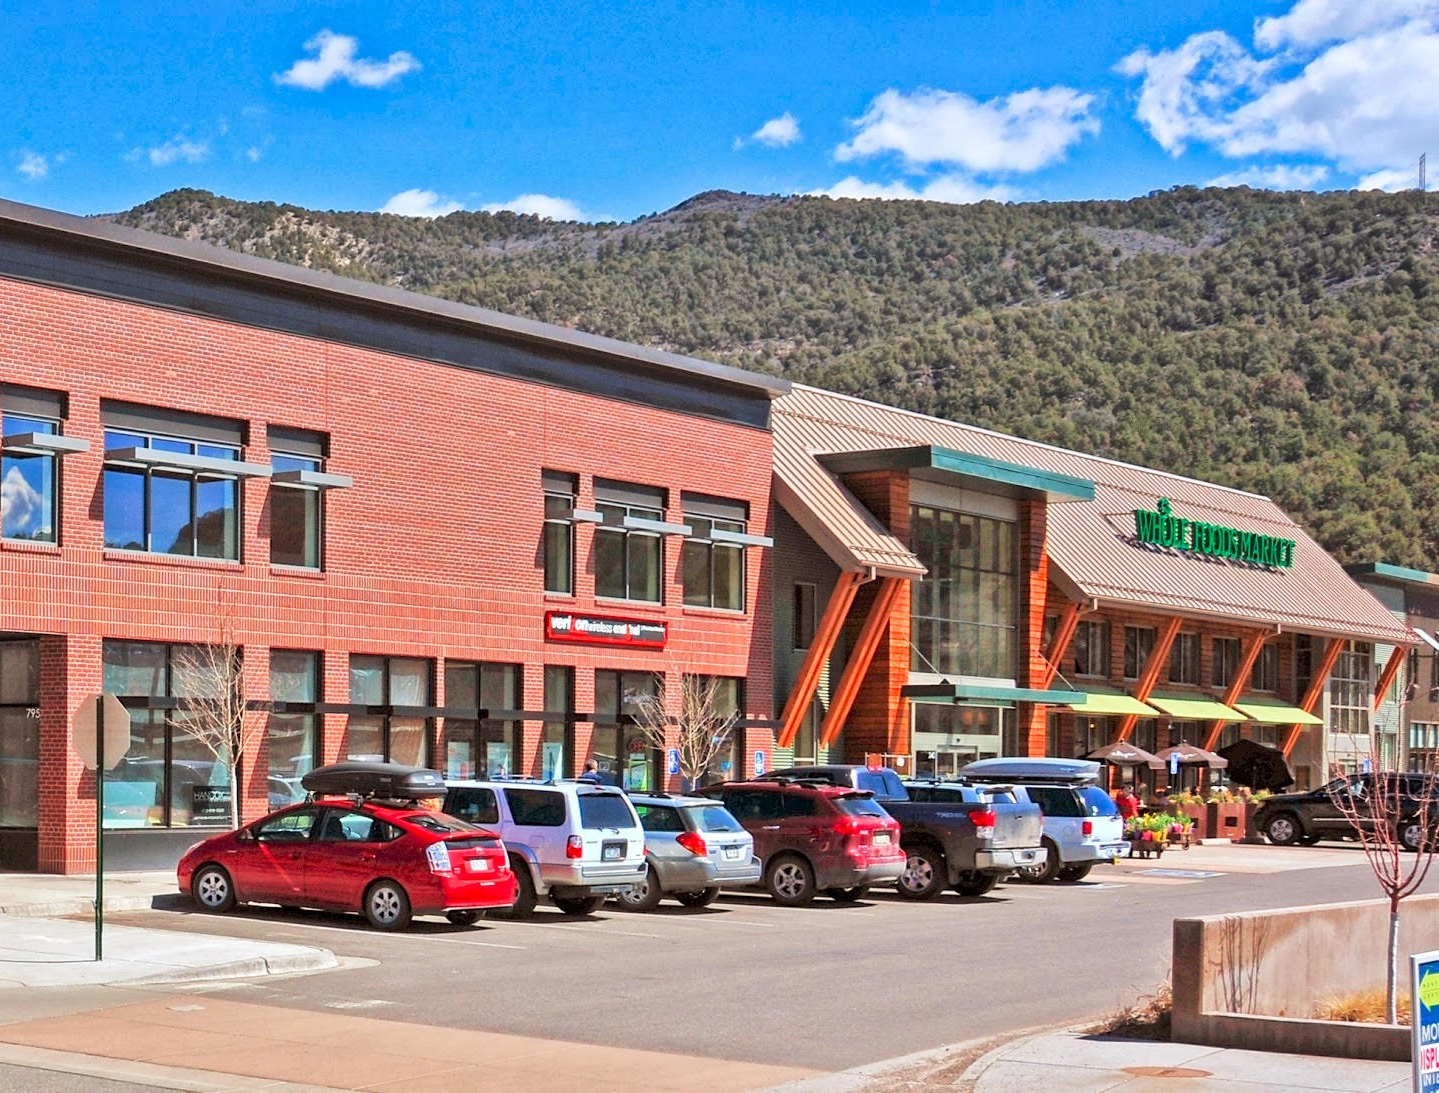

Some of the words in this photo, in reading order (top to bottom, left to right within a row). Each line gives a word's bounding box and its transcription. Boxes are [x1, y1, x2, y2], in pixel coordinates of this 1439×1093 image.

[1135, 508, 1190, 550] WHOLE
[1192, 520, 1240, 560] FOODS
[1239, 531, 1296, 568] MARKET
[26, 708, 41, 719] 795
